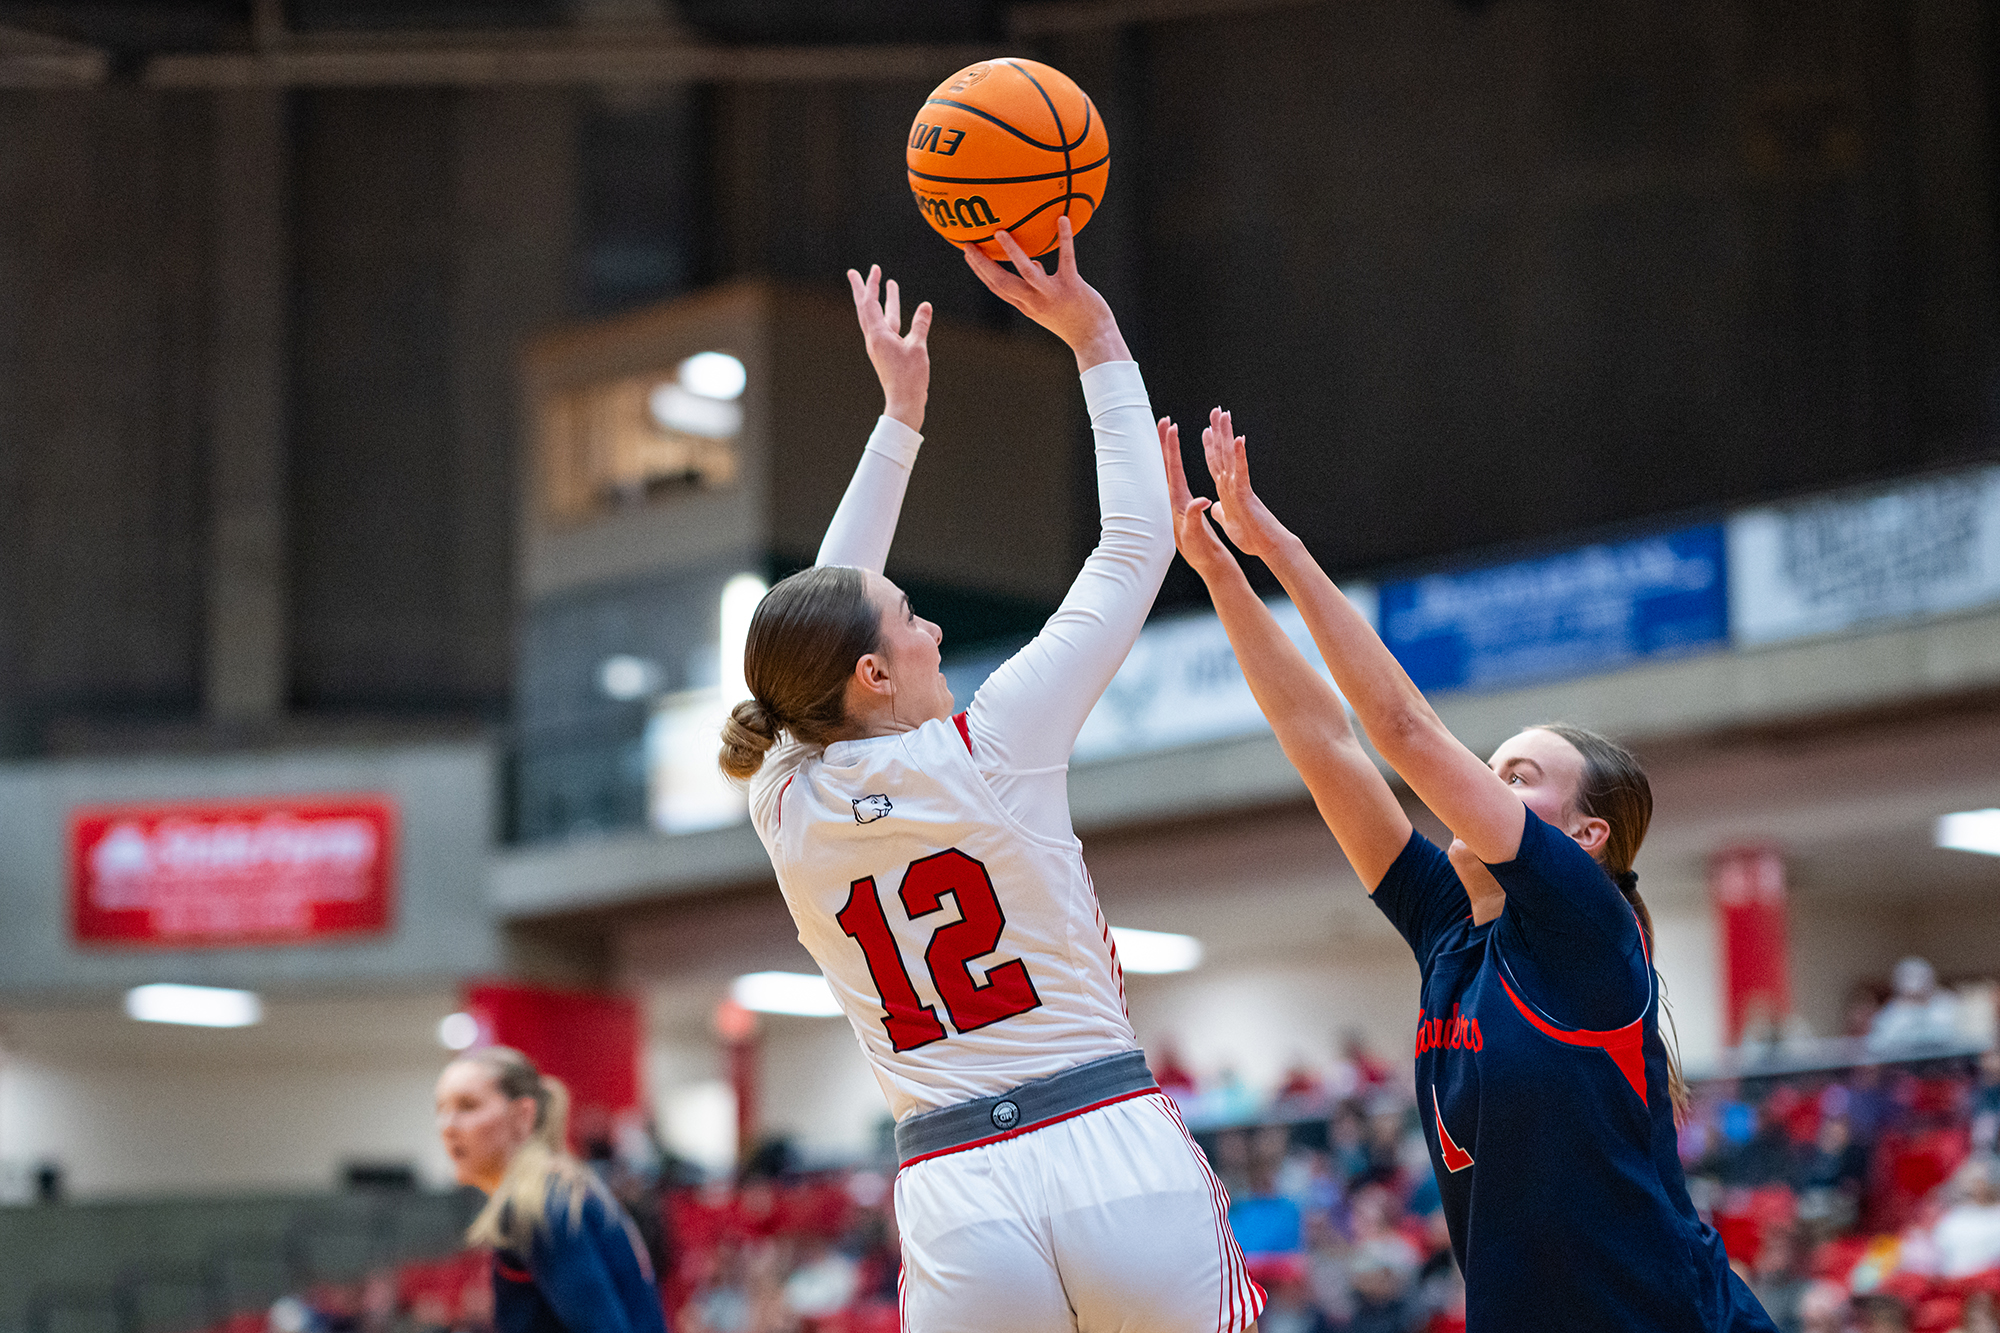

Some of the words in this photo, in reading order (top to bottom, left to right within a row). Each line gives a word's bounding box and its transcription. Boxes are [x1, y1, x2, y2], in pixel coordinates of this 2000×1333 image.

[910, 122, 966, 156] EVO
[835, 847, 1043, 1053] 12
[1432, 1084, 1475, 1173] 1
